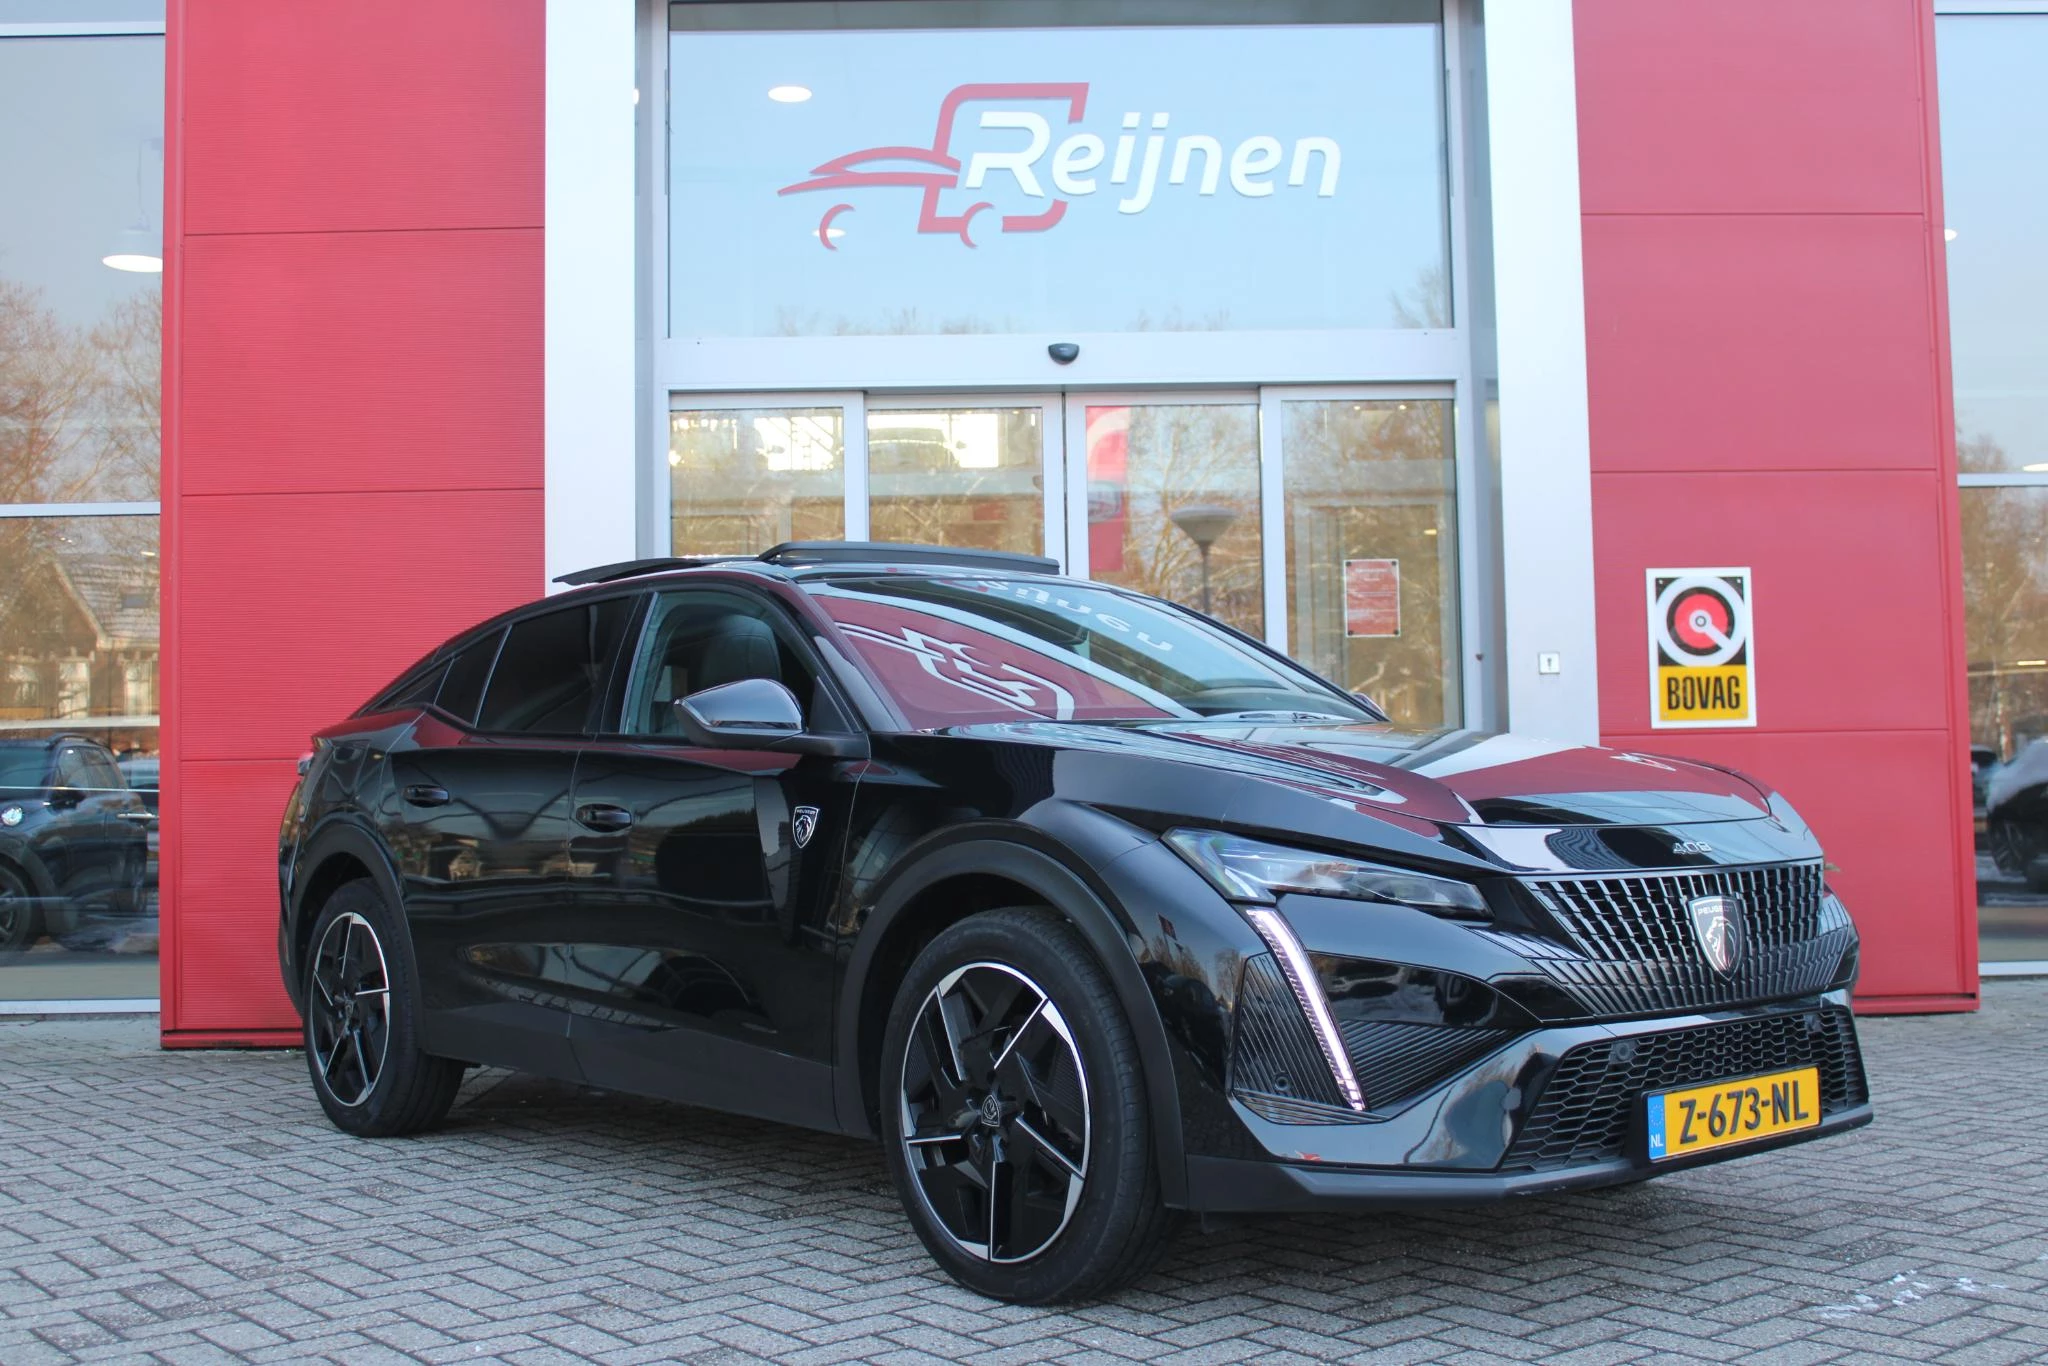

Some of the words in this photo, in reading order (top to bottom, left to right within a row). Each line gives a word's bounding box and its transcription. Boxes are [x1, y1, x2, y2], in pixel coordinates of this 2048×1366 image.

[965, 111, 1342, 214] Reijnen
[1667, 676, 1740, 711] BOVAG
[1673, 841, 1712, 854] 408
[1679, 1079, 1809, 1145] Z-673-NL
[1650, 1134, 1664, 1149] NL
